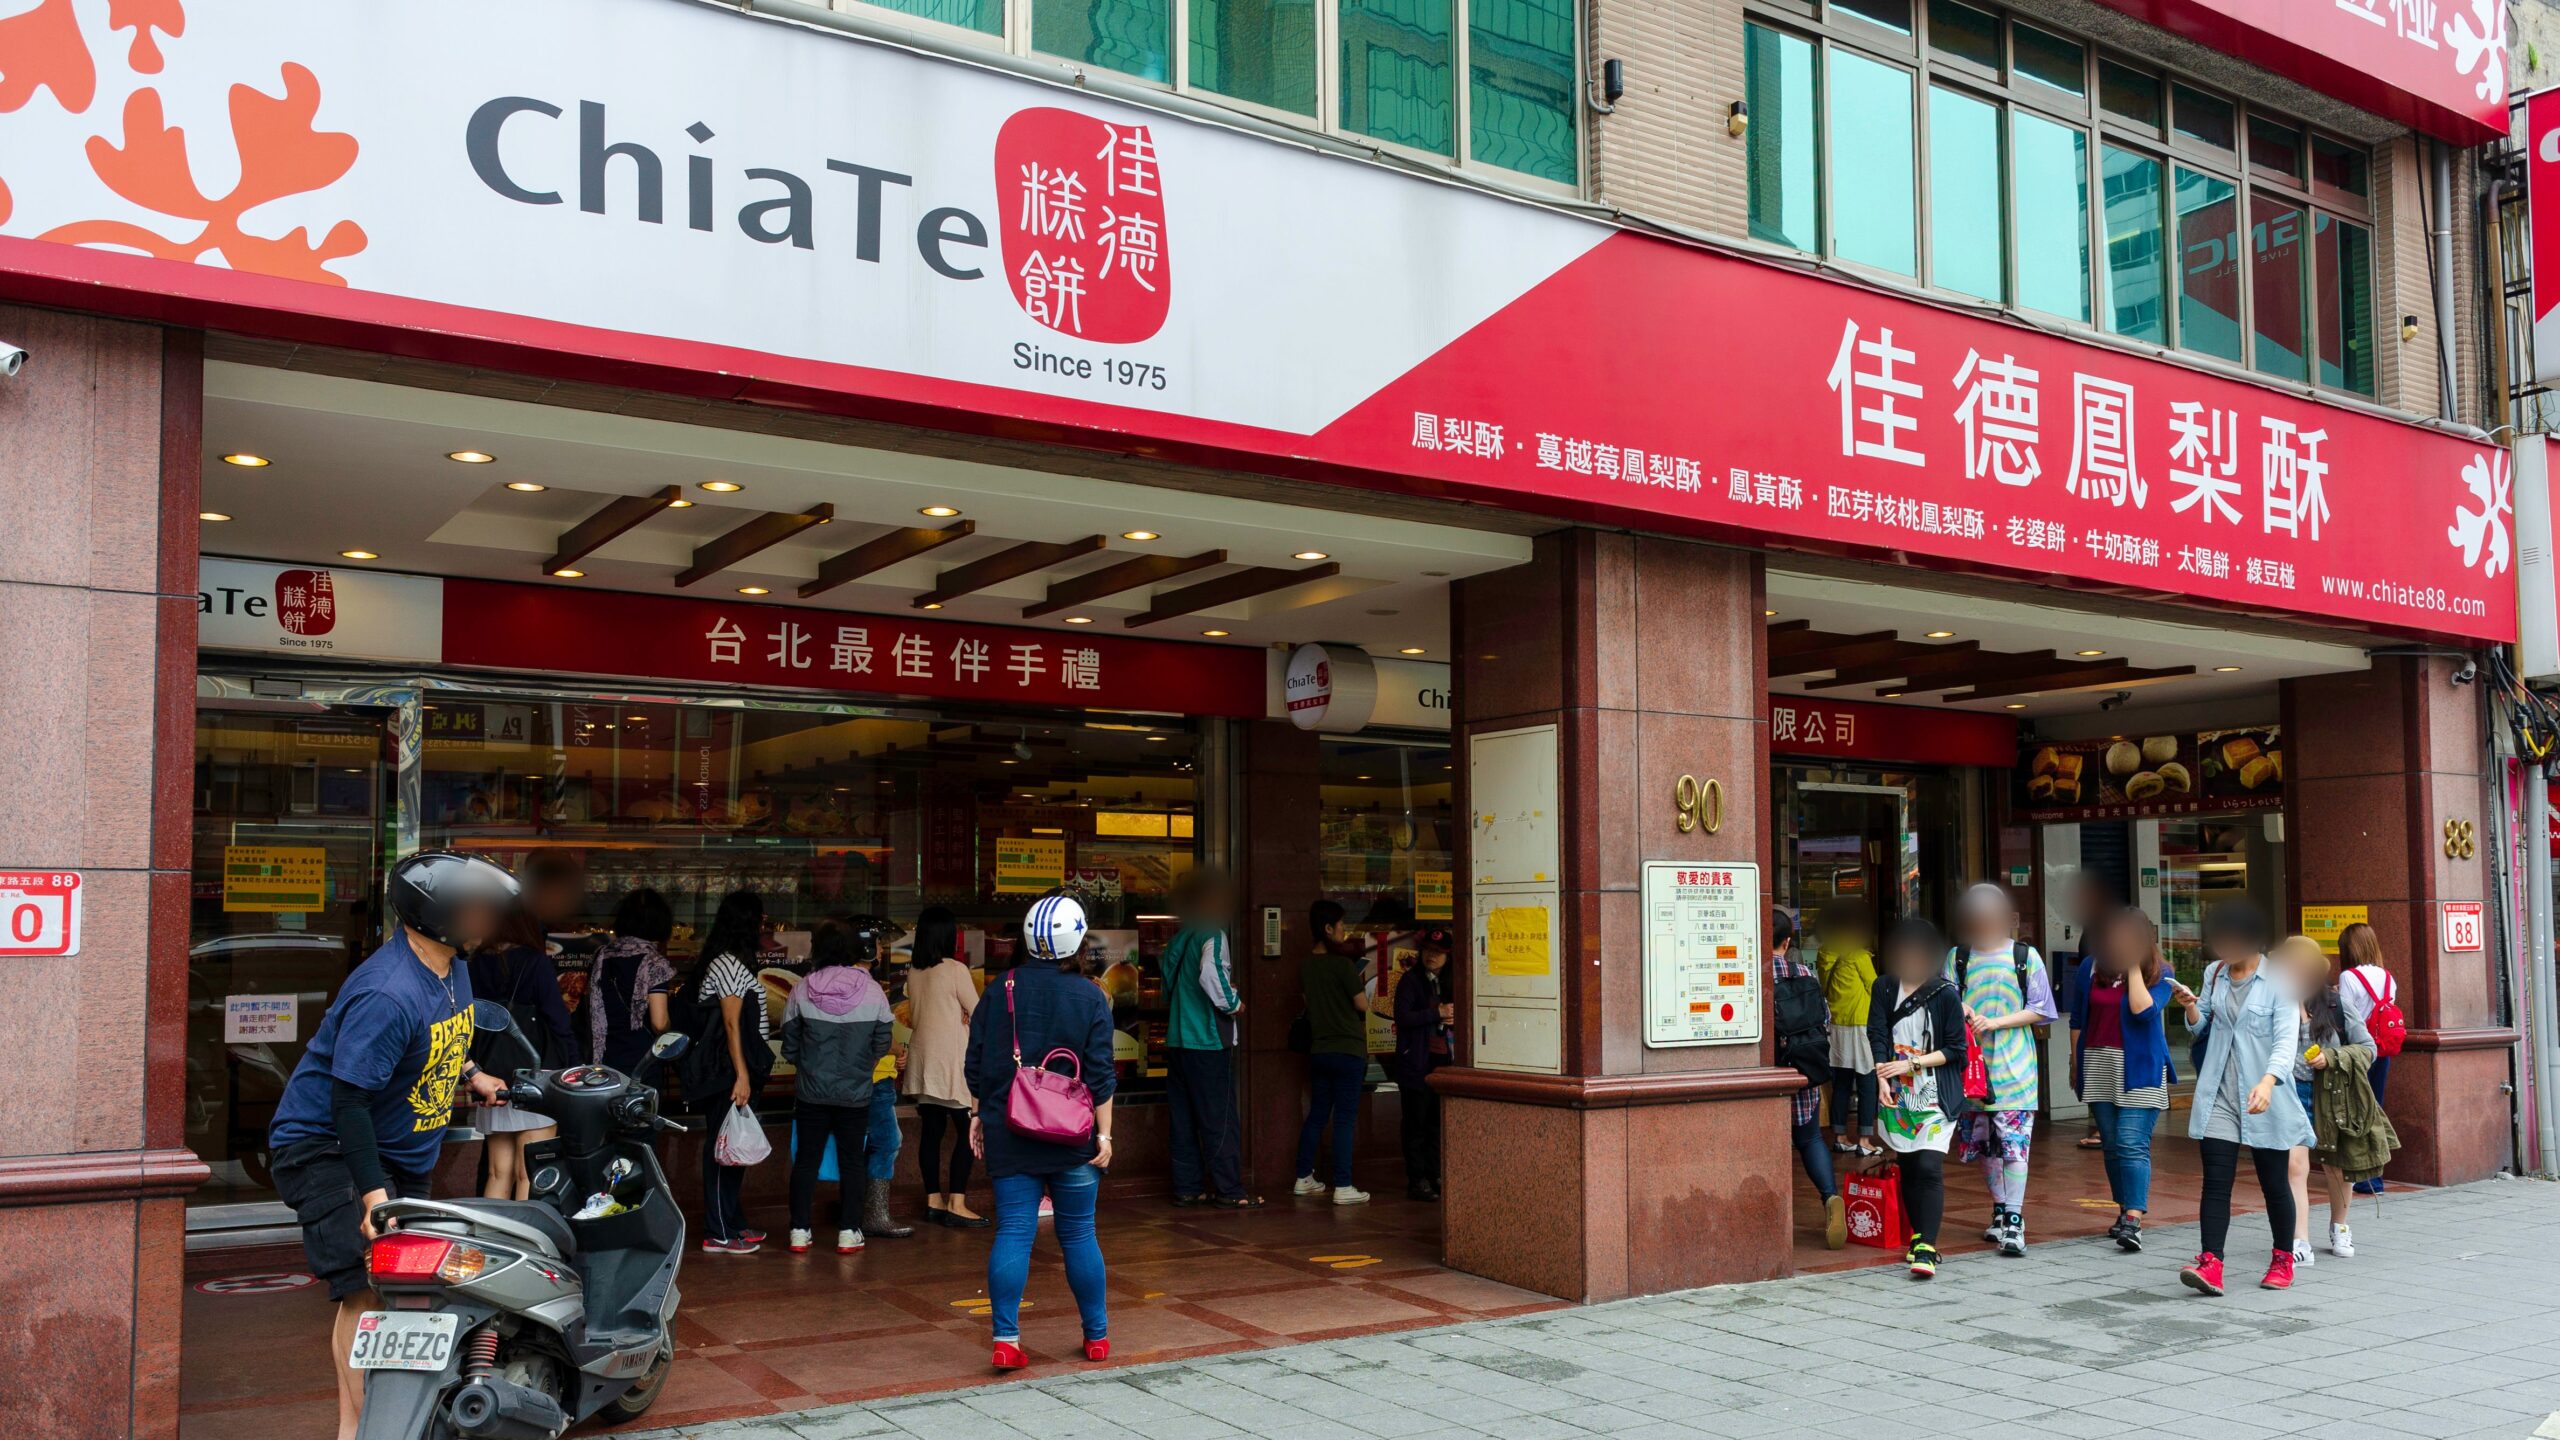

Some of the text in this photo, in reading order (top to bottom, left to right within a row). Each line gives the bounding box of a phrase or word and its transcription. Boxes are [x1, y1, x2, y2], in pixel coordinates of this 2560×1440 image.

[466, 96, 989, 280] ChiaTe
[1097, 123, 1158, 292] 佳德
[1020, 161, 1087, 333] 糕餅
[1013, 342, 1166, 390] Since 1975
[1827, 318, 2330, 543] 佳德鳳梨酥
[310, 571, 332, 620] 佳德
[2322, 576, 2486, 617] www.chiate88.com
[280, 637, 333, 649] Since 1975
[706, 616, 1100, 690] 台北最佳伴手禮
[1287, 674, 1316, 689] ChiaTe
[1418, 688, 1451, 709] Chi
[1772, 707, 1855, 746] 限公司
[1676, 774, 1724, 834] 90
[2031, 811, 2064, 820] Welcome
[2444, 818, 2474, 859] 88
[52, 875, 73, 887] 88
[1676, 871, 1733, 886] 敬愛的貴賓
[12, 903, 43, 942] 0
[2456, 922, 2472, 944] 88
[621, 1352, 648, 1370] YAMAHA
